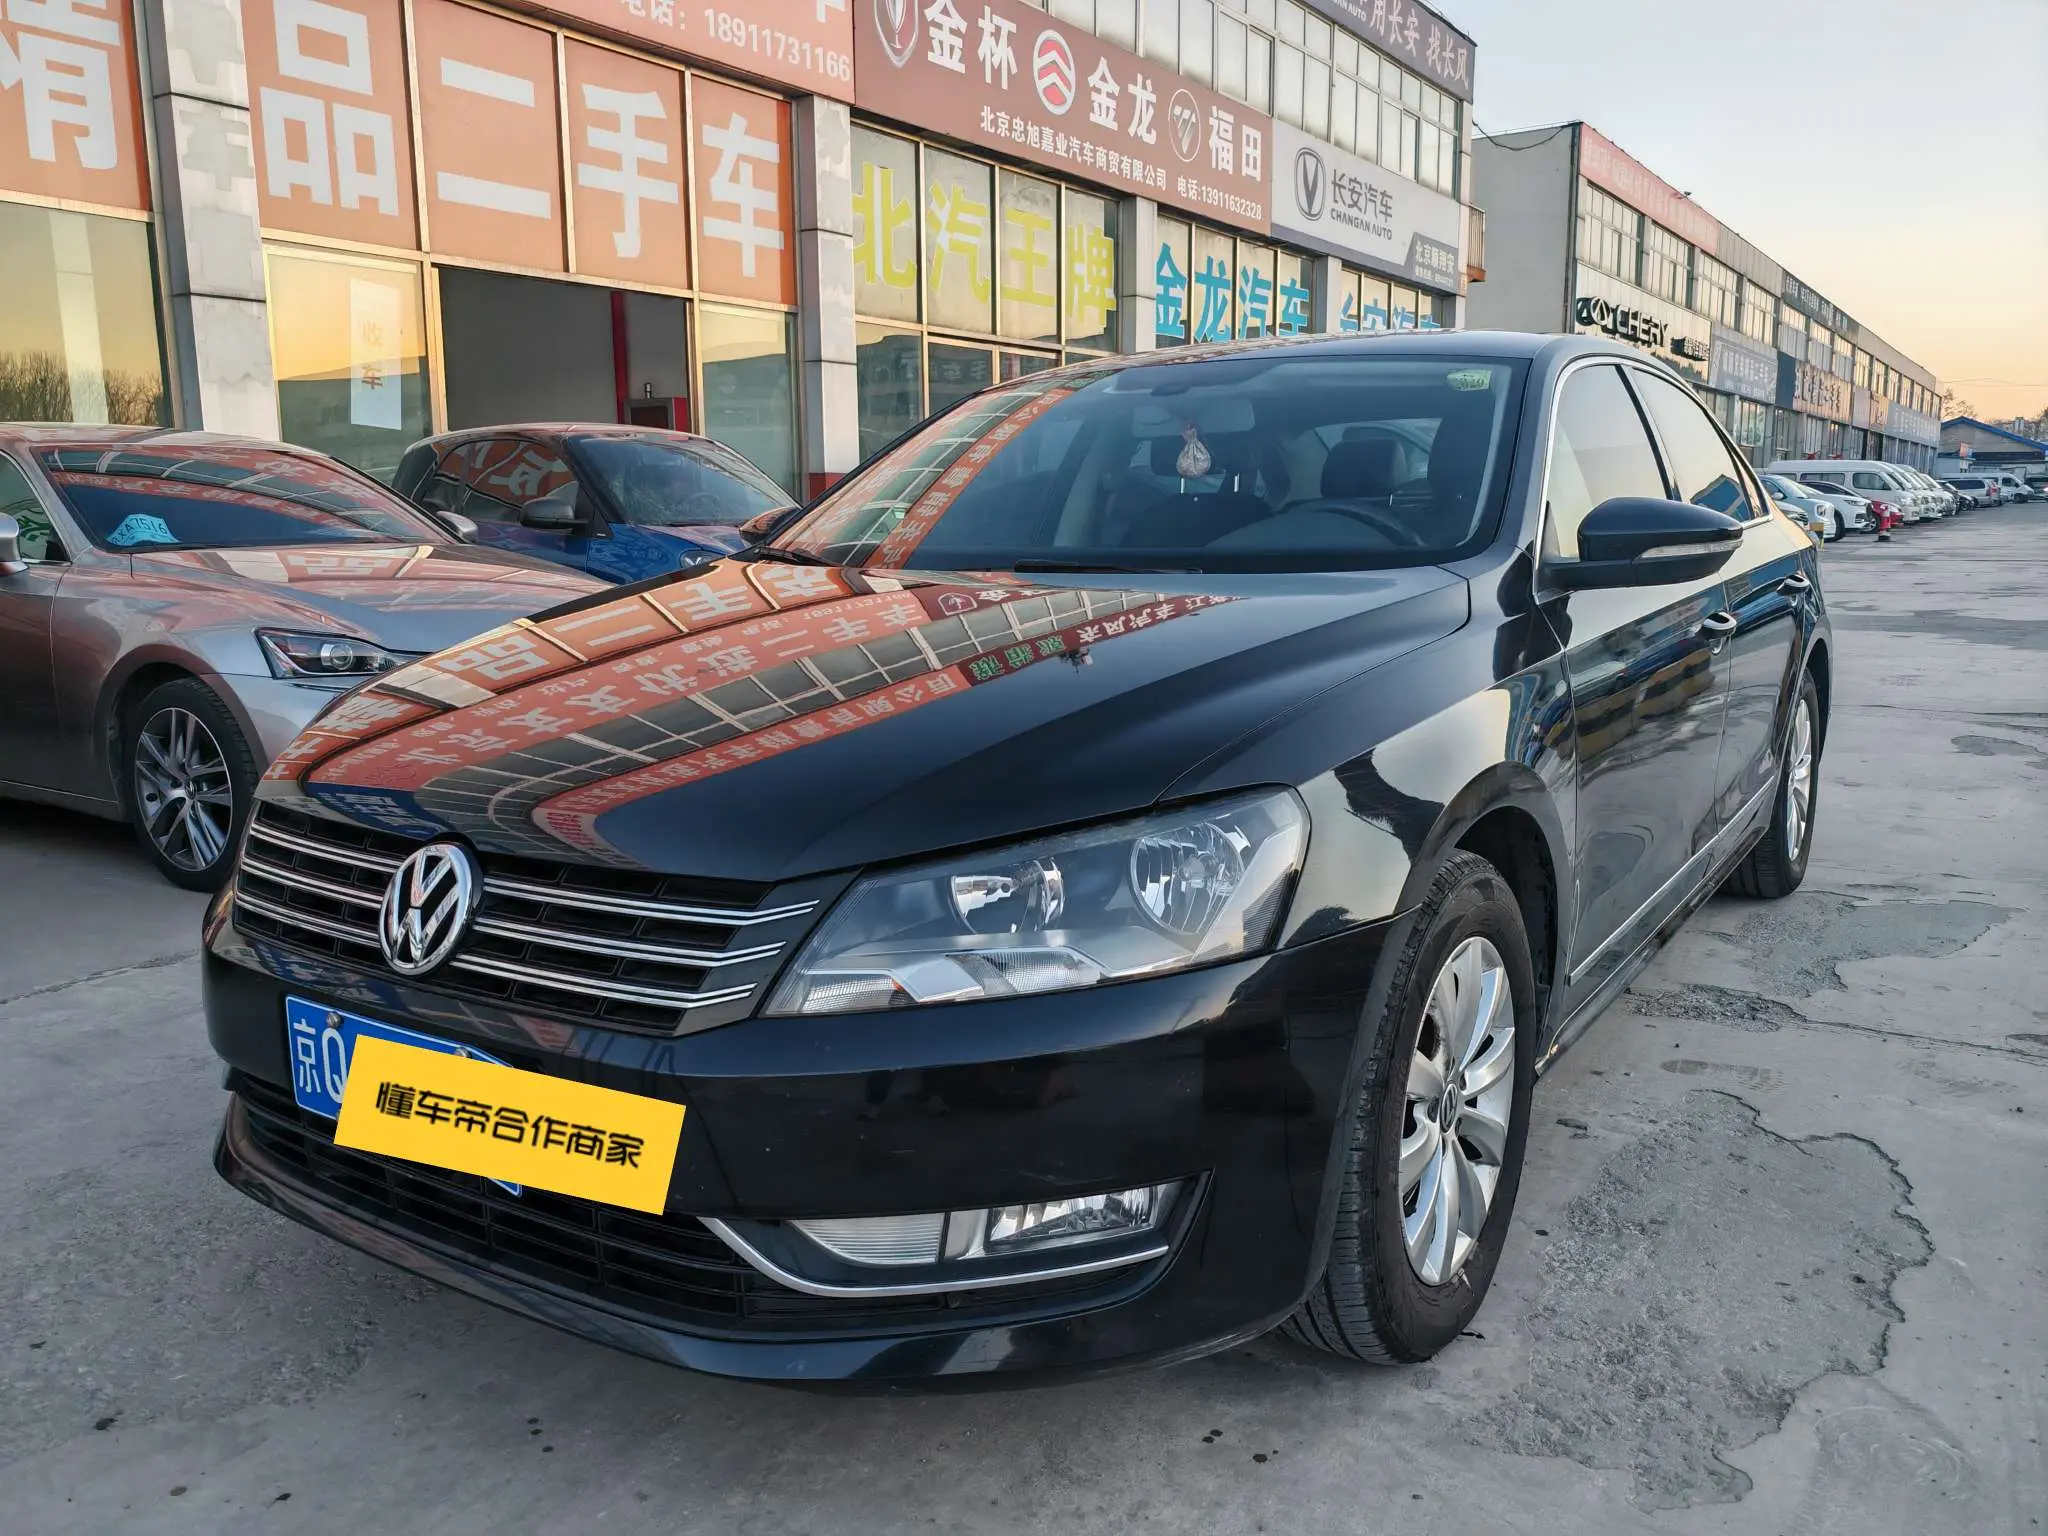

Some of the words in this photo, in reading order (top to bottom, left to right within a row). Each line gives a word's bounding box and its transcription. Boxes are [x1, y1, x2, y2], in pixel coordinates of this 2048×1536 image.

[924, 0, 1018, 90] 金杯
[1088, 56, 1158, 145] 金龙
[1209, 105, 1263, 182] 福田
[980, 105, 1167, 191] 北京忠旭嘉业汽车商贸有限公司
[1331, 207, 1370, 233] CHANGAN
[1372, 225, 1393, 241] AUTO
[1332, 169, 1393, 223] 长安汽车
[854, 161, 1117, 330] 北汽王牌
[1155, 242, 1311, 342] 金龙汽车
[1616, 303, 1669, 345] CHERY
